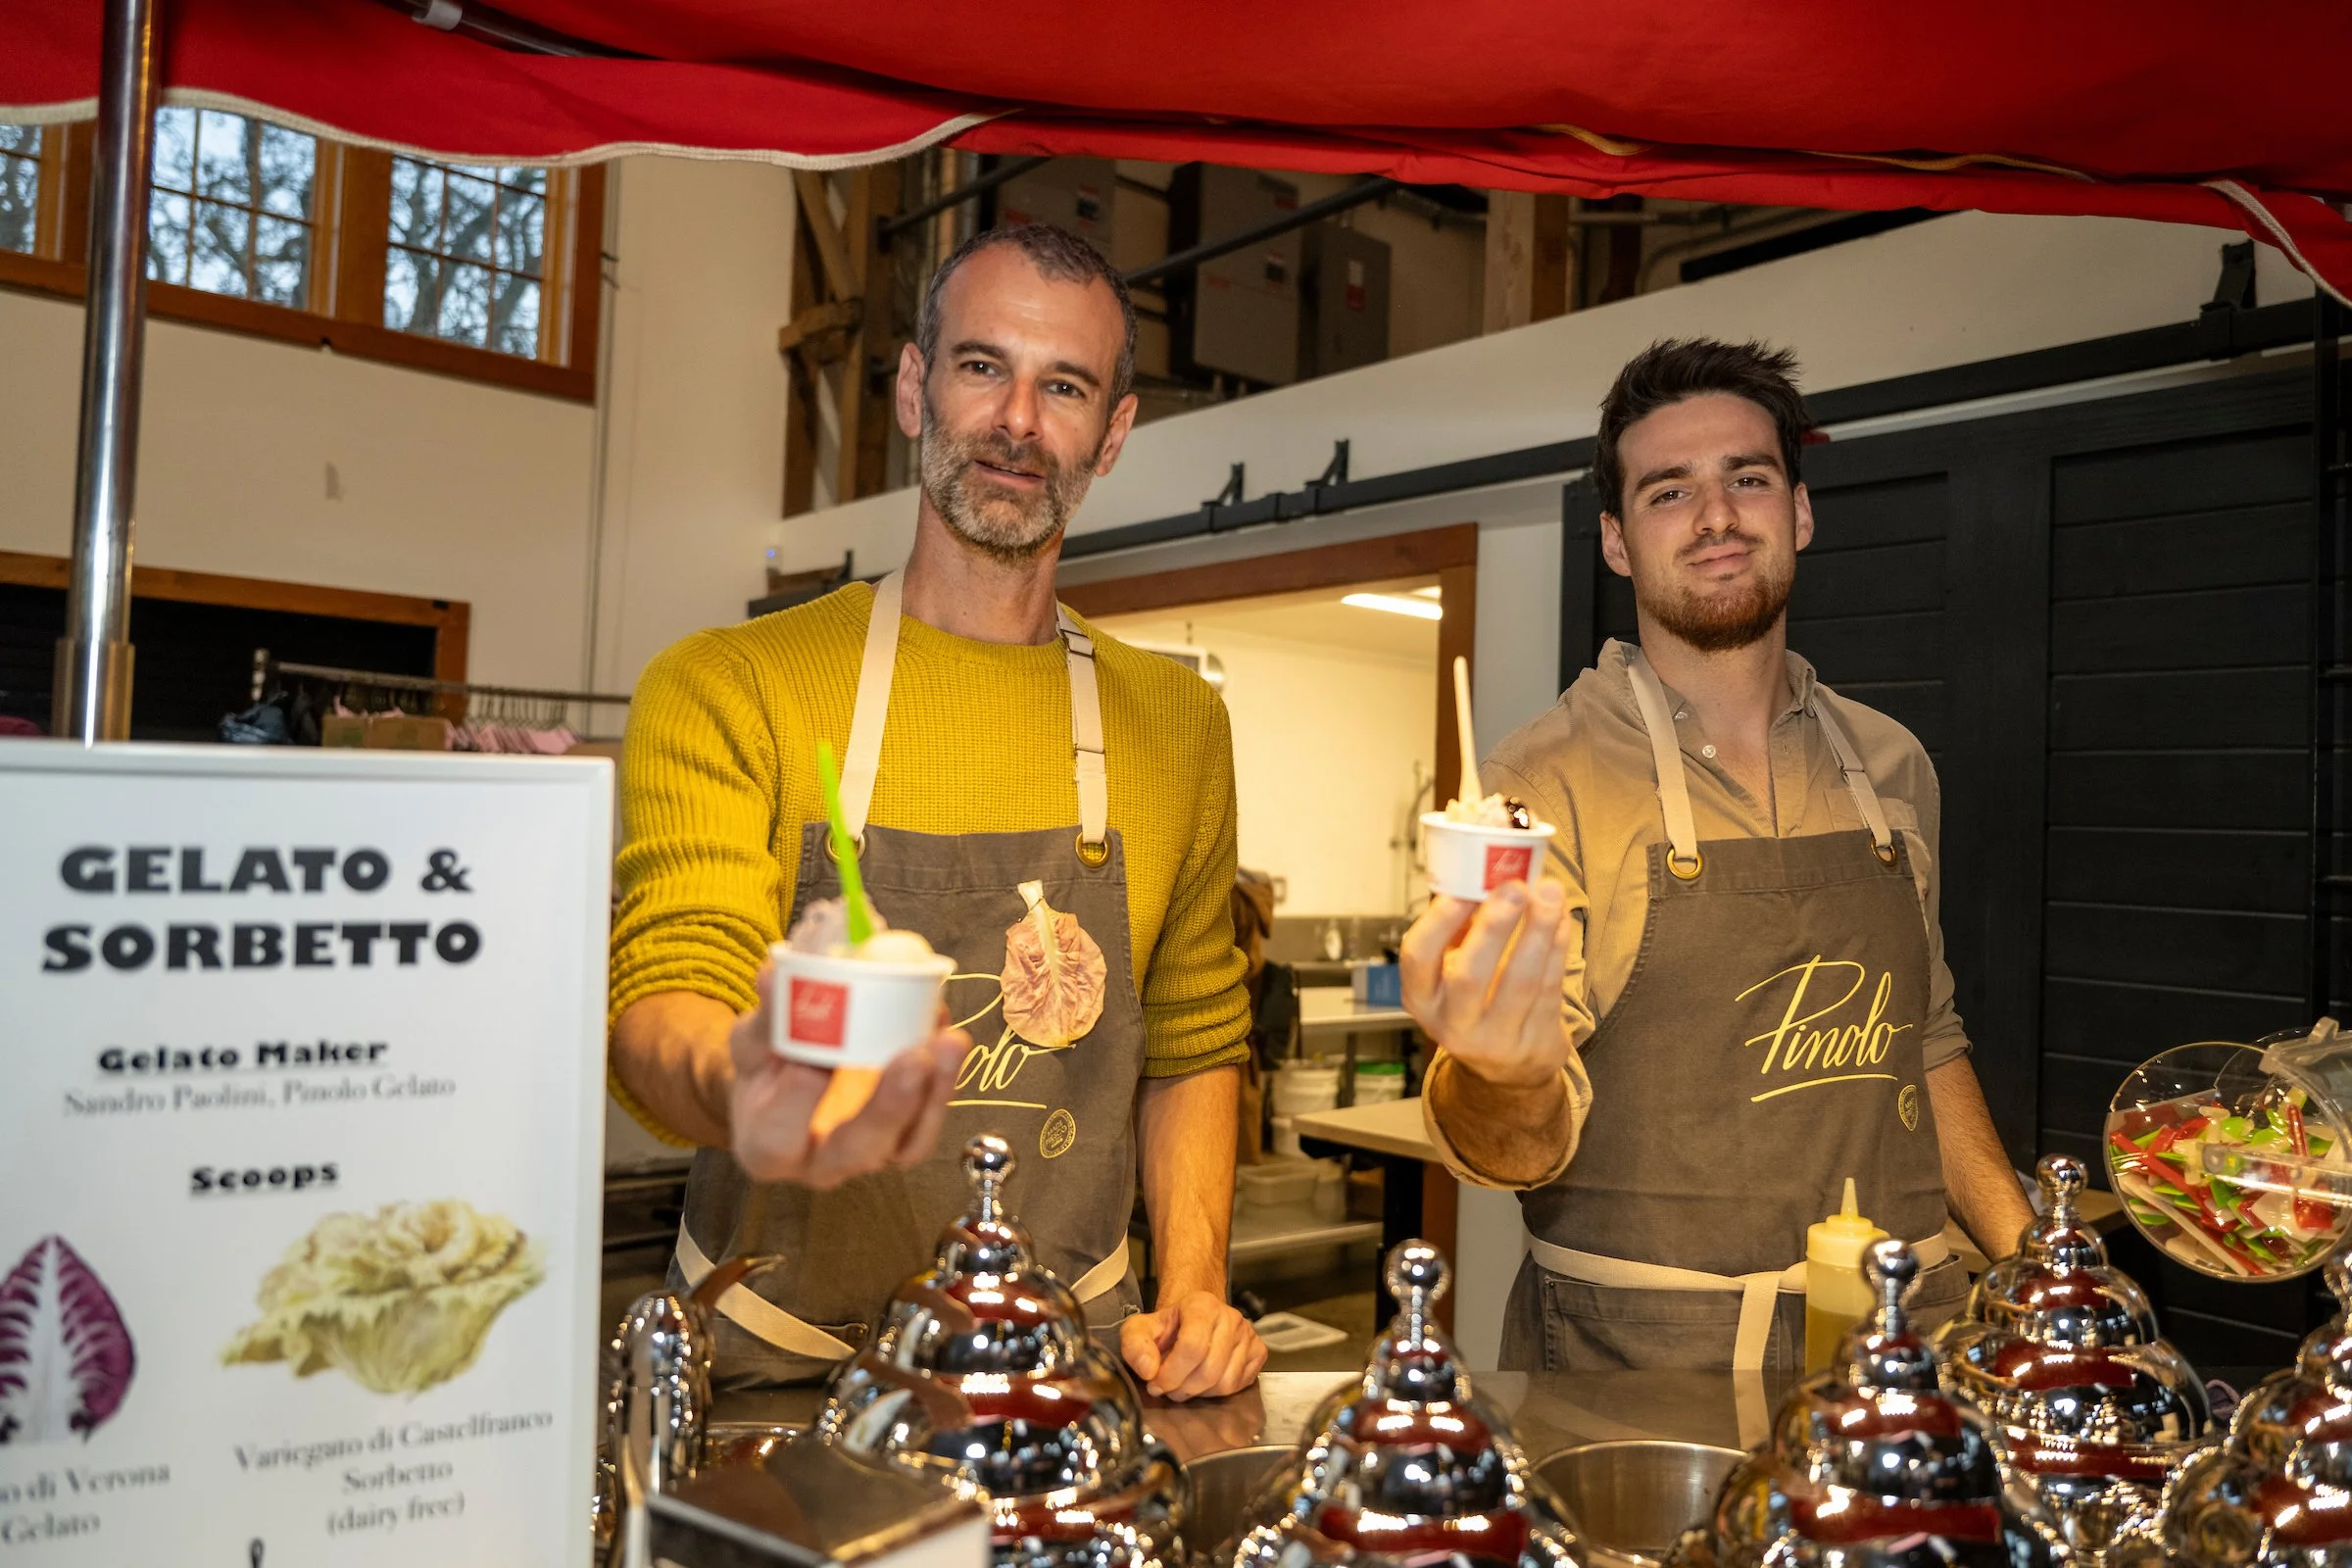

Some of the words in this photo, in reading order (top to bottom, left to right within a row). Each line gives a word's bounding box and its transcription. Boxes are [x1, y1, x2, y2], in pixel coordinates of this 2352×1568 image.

[59, 845, 391, 896] GELATO
[419, 847, 474, 895] &
[41, 919, 482, 975] SORBETTO
[1734, 954, 1914, 1075] Pinolo
[97, 1045, 241, 1074] Gelato
[256, 1040, 389, 1068] Maker
[65, 1090, 167, 1116] Sandro
[283, 1078, 368, 1104] Pinolo
[372, 1075, 458, 1101] Gelato
[190, 1162, 339, 1195] Scoops
[368, 1427, 394, 1454] di
[399, 1411, 554, 1447] Castelfranco
[26, 1471, 56, 1501] di
[66, 1465, 171, 1494] Verona
[342, 1463, 453, 1494] Sorbetto
[1, 1512, 100, 1545] Gelato
